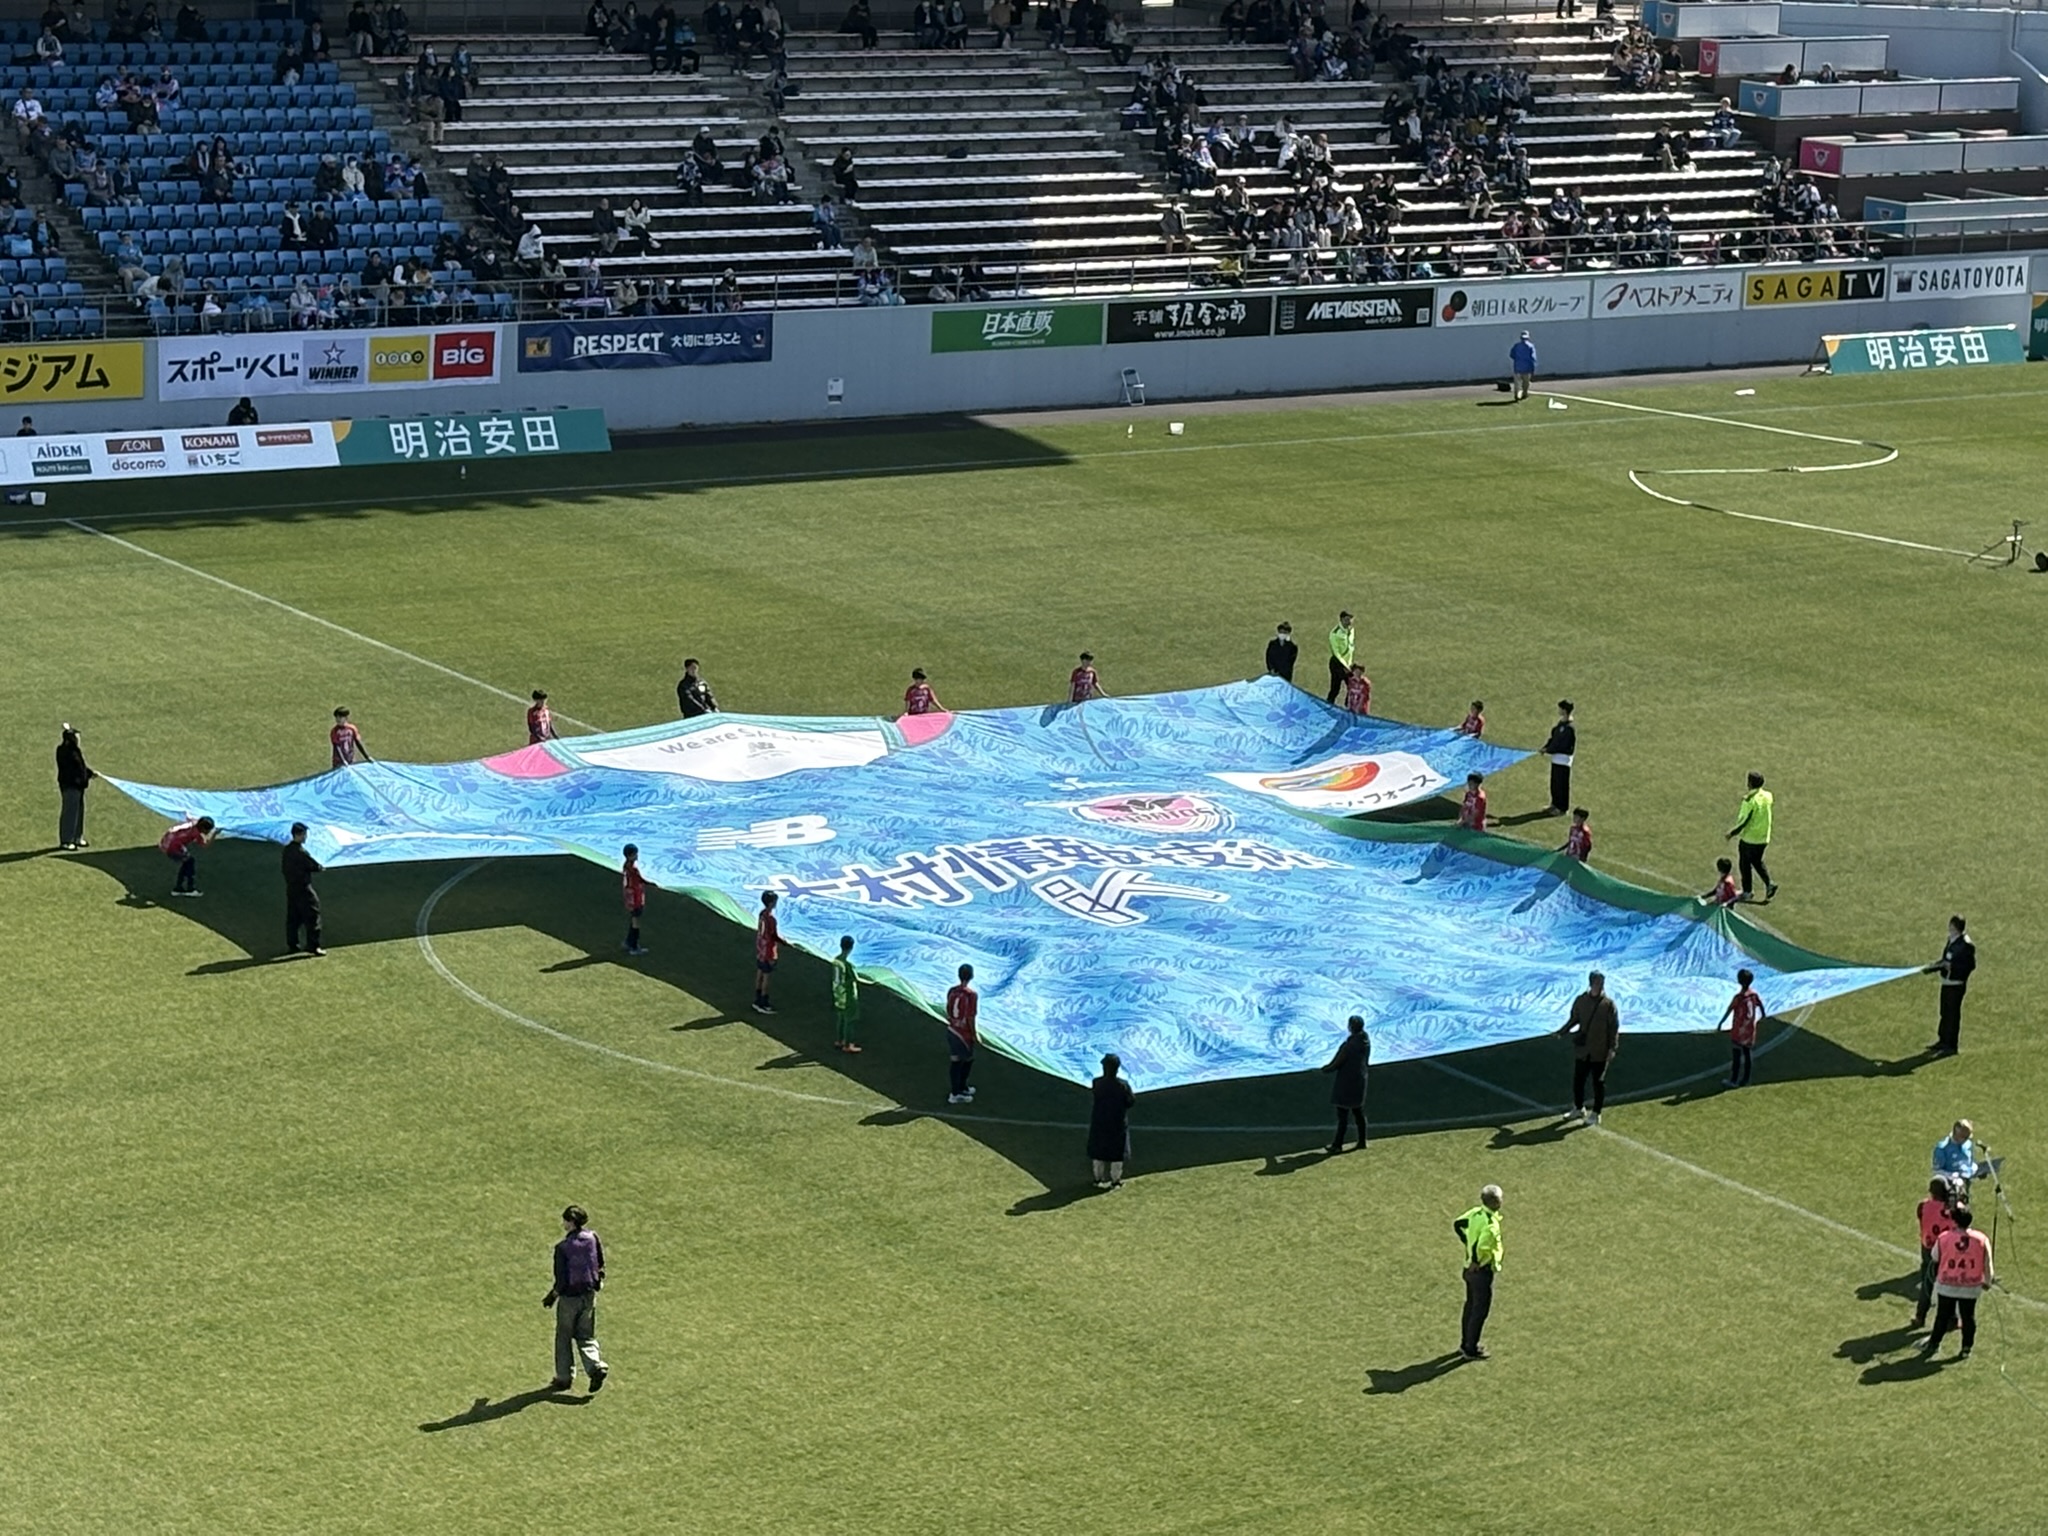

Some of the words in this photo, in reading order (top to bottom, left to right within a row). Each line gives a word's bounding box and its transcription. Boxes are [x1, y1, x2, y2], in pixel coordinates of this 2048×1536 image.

[1752, 276, 1834, 300] SAGA
[1845, 272, 1881, 296] TV
[1918, 265, 2024, 291] SAGATOYOTA
[1629, 284, 1733, 308] ベストアメニティ
[982, 310, 1055, 336] 日本直販
[573, 332, 664, 355] RESPECT
[1866, 332, 1989, 370] 明治安田
[0, 353, 110, 393] ジアム
[167, 351, 299, 383] スポーツくじ
[308, 366, 359, 380] WINNER
[184, 434, 237, 448] KONAMI
[389, 416, 560, 459] 明治安田
[112, 458, 166, 471] docomo
[200, 452, 241, 466] いちご
